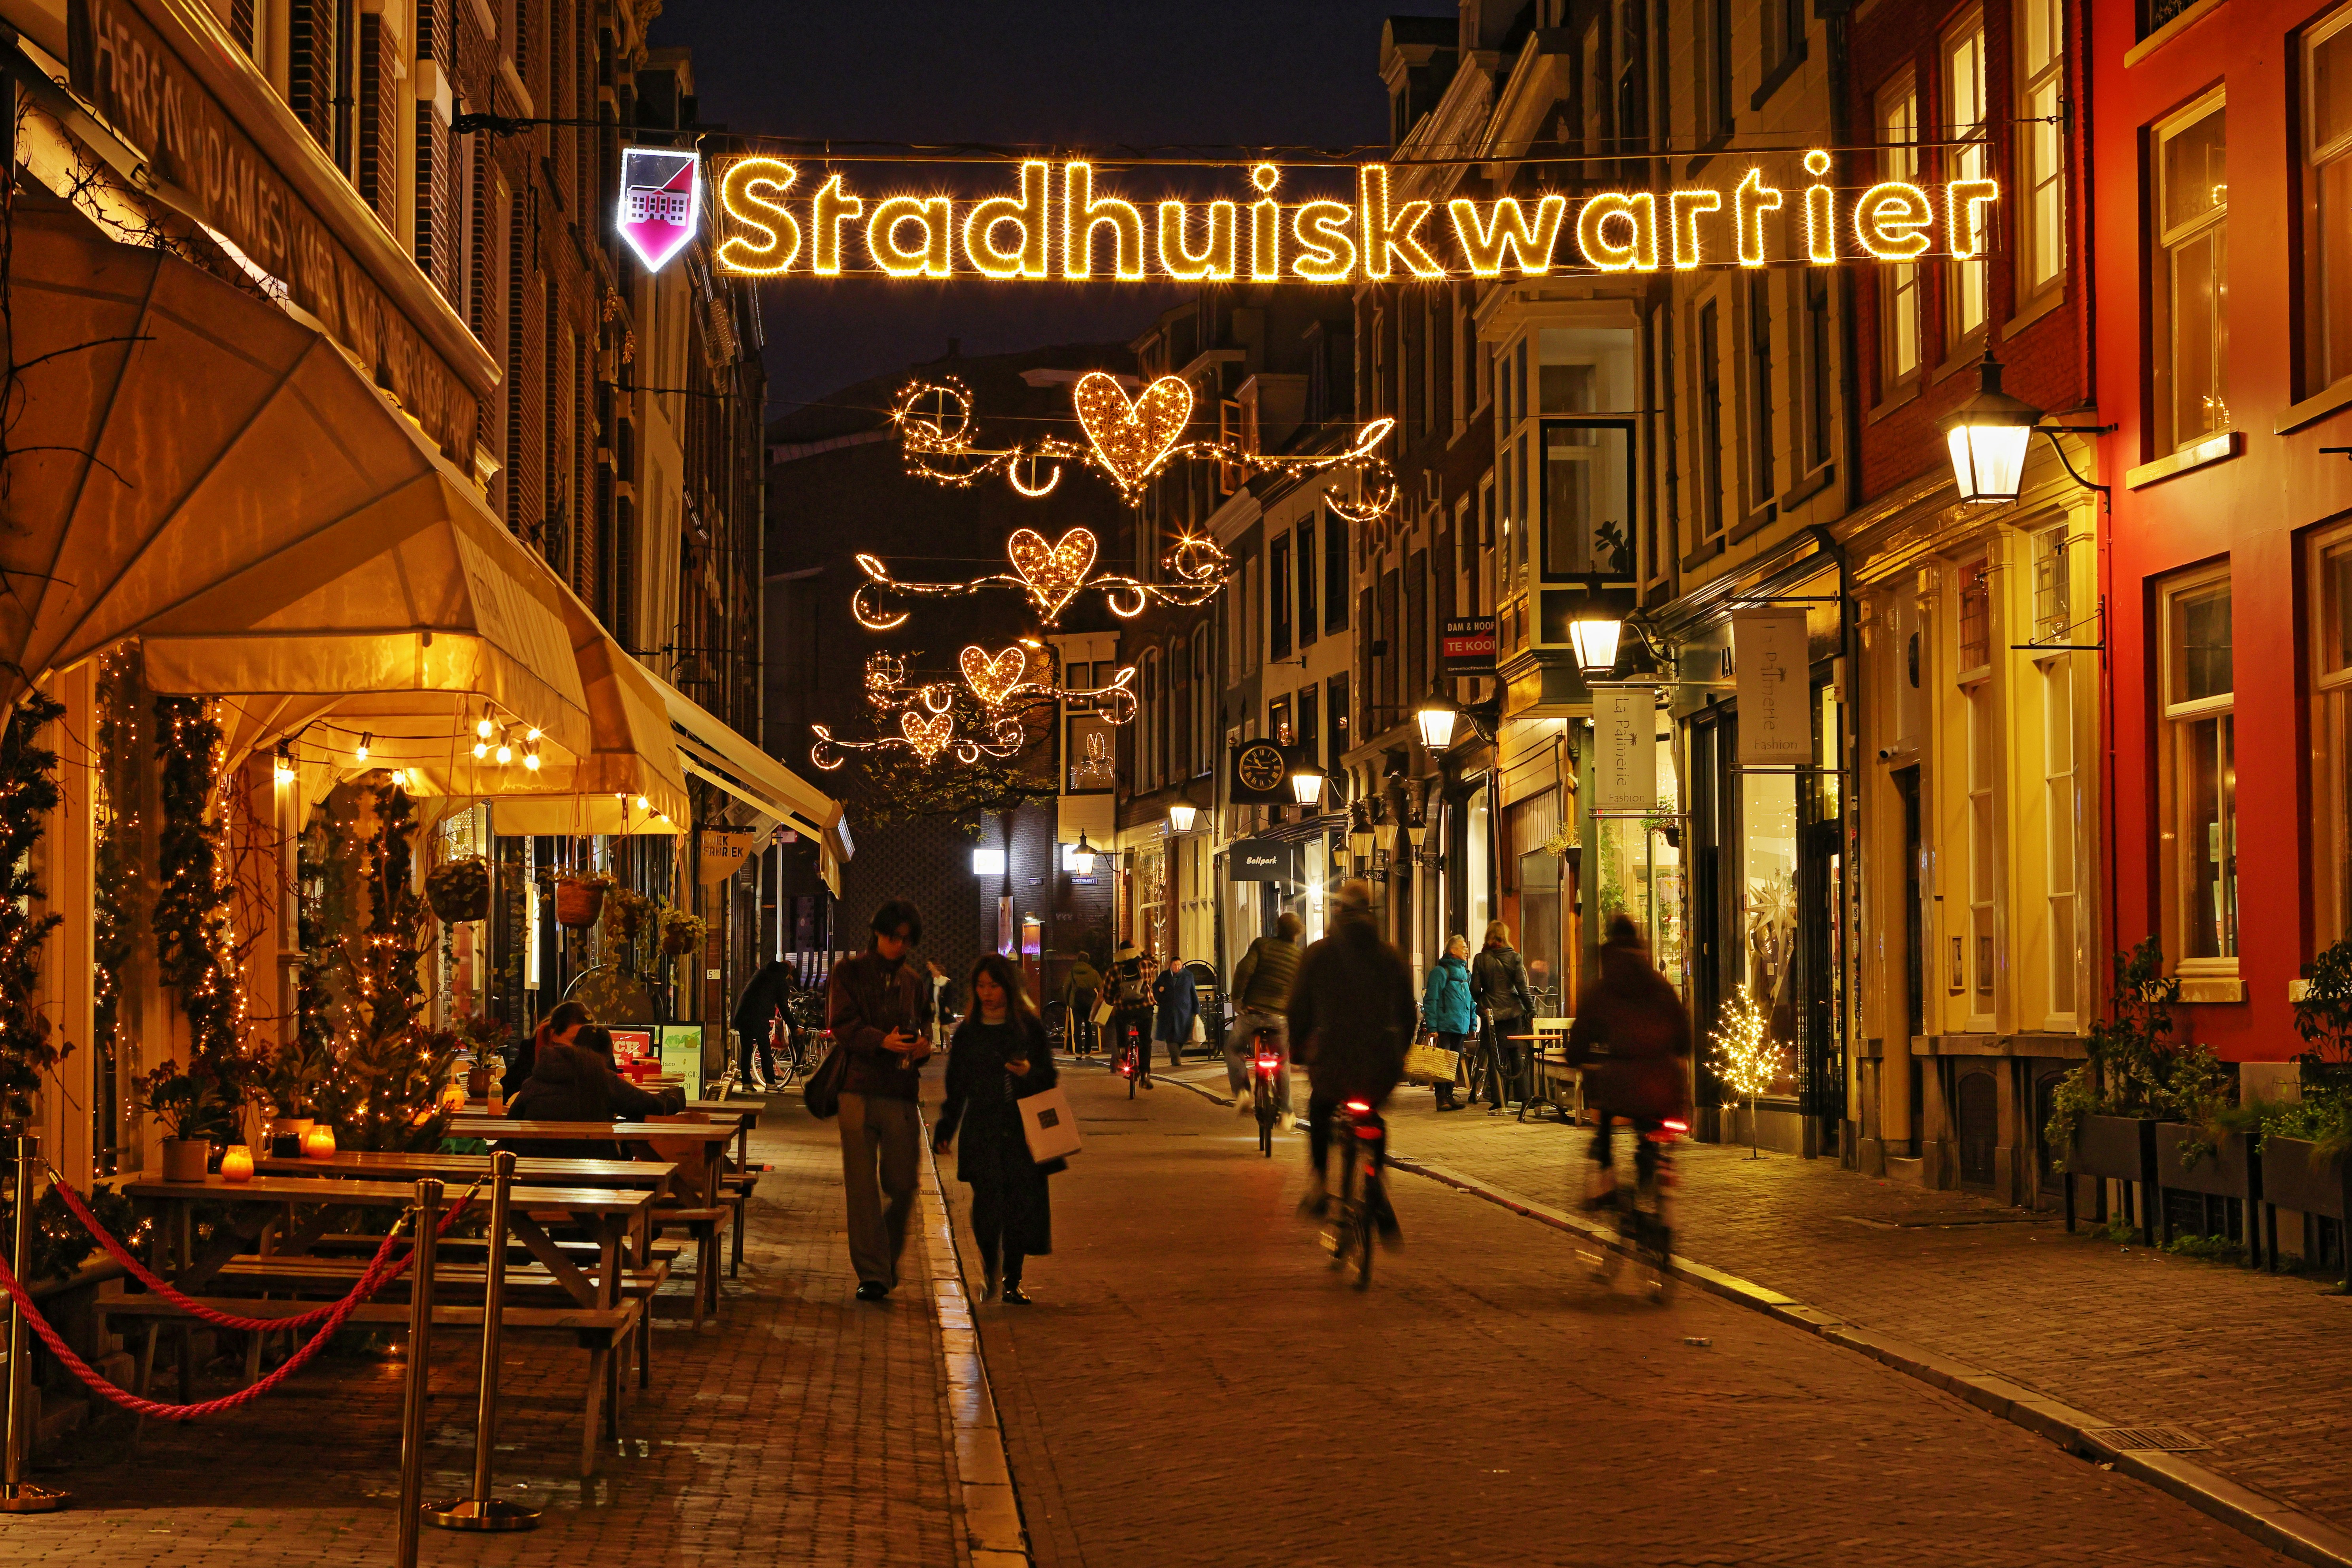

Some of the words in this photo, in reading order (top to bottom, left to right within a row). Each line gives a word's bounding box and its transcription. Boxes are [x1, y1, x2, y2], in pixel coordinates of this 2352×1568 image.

[208, 126, 285, 259] DAMES
[718, 149, 1999, 281] Stadhuiskwartier
[1448, 623, 1464, 632] DAM
[1467, 622, 1471, 630] &
[1474, 621, 1495, 630] HOOF
[1448, 642, 1462, 651] TE
[1614, 698, 1629, 713] La
[1754, 737, 1797, 750] Fashion
[1615, 721, 1630, 786] Palmerie
[1609, 792, 1645, 803] Fashion
[1246, 856, 1278, 866] Ballpark
